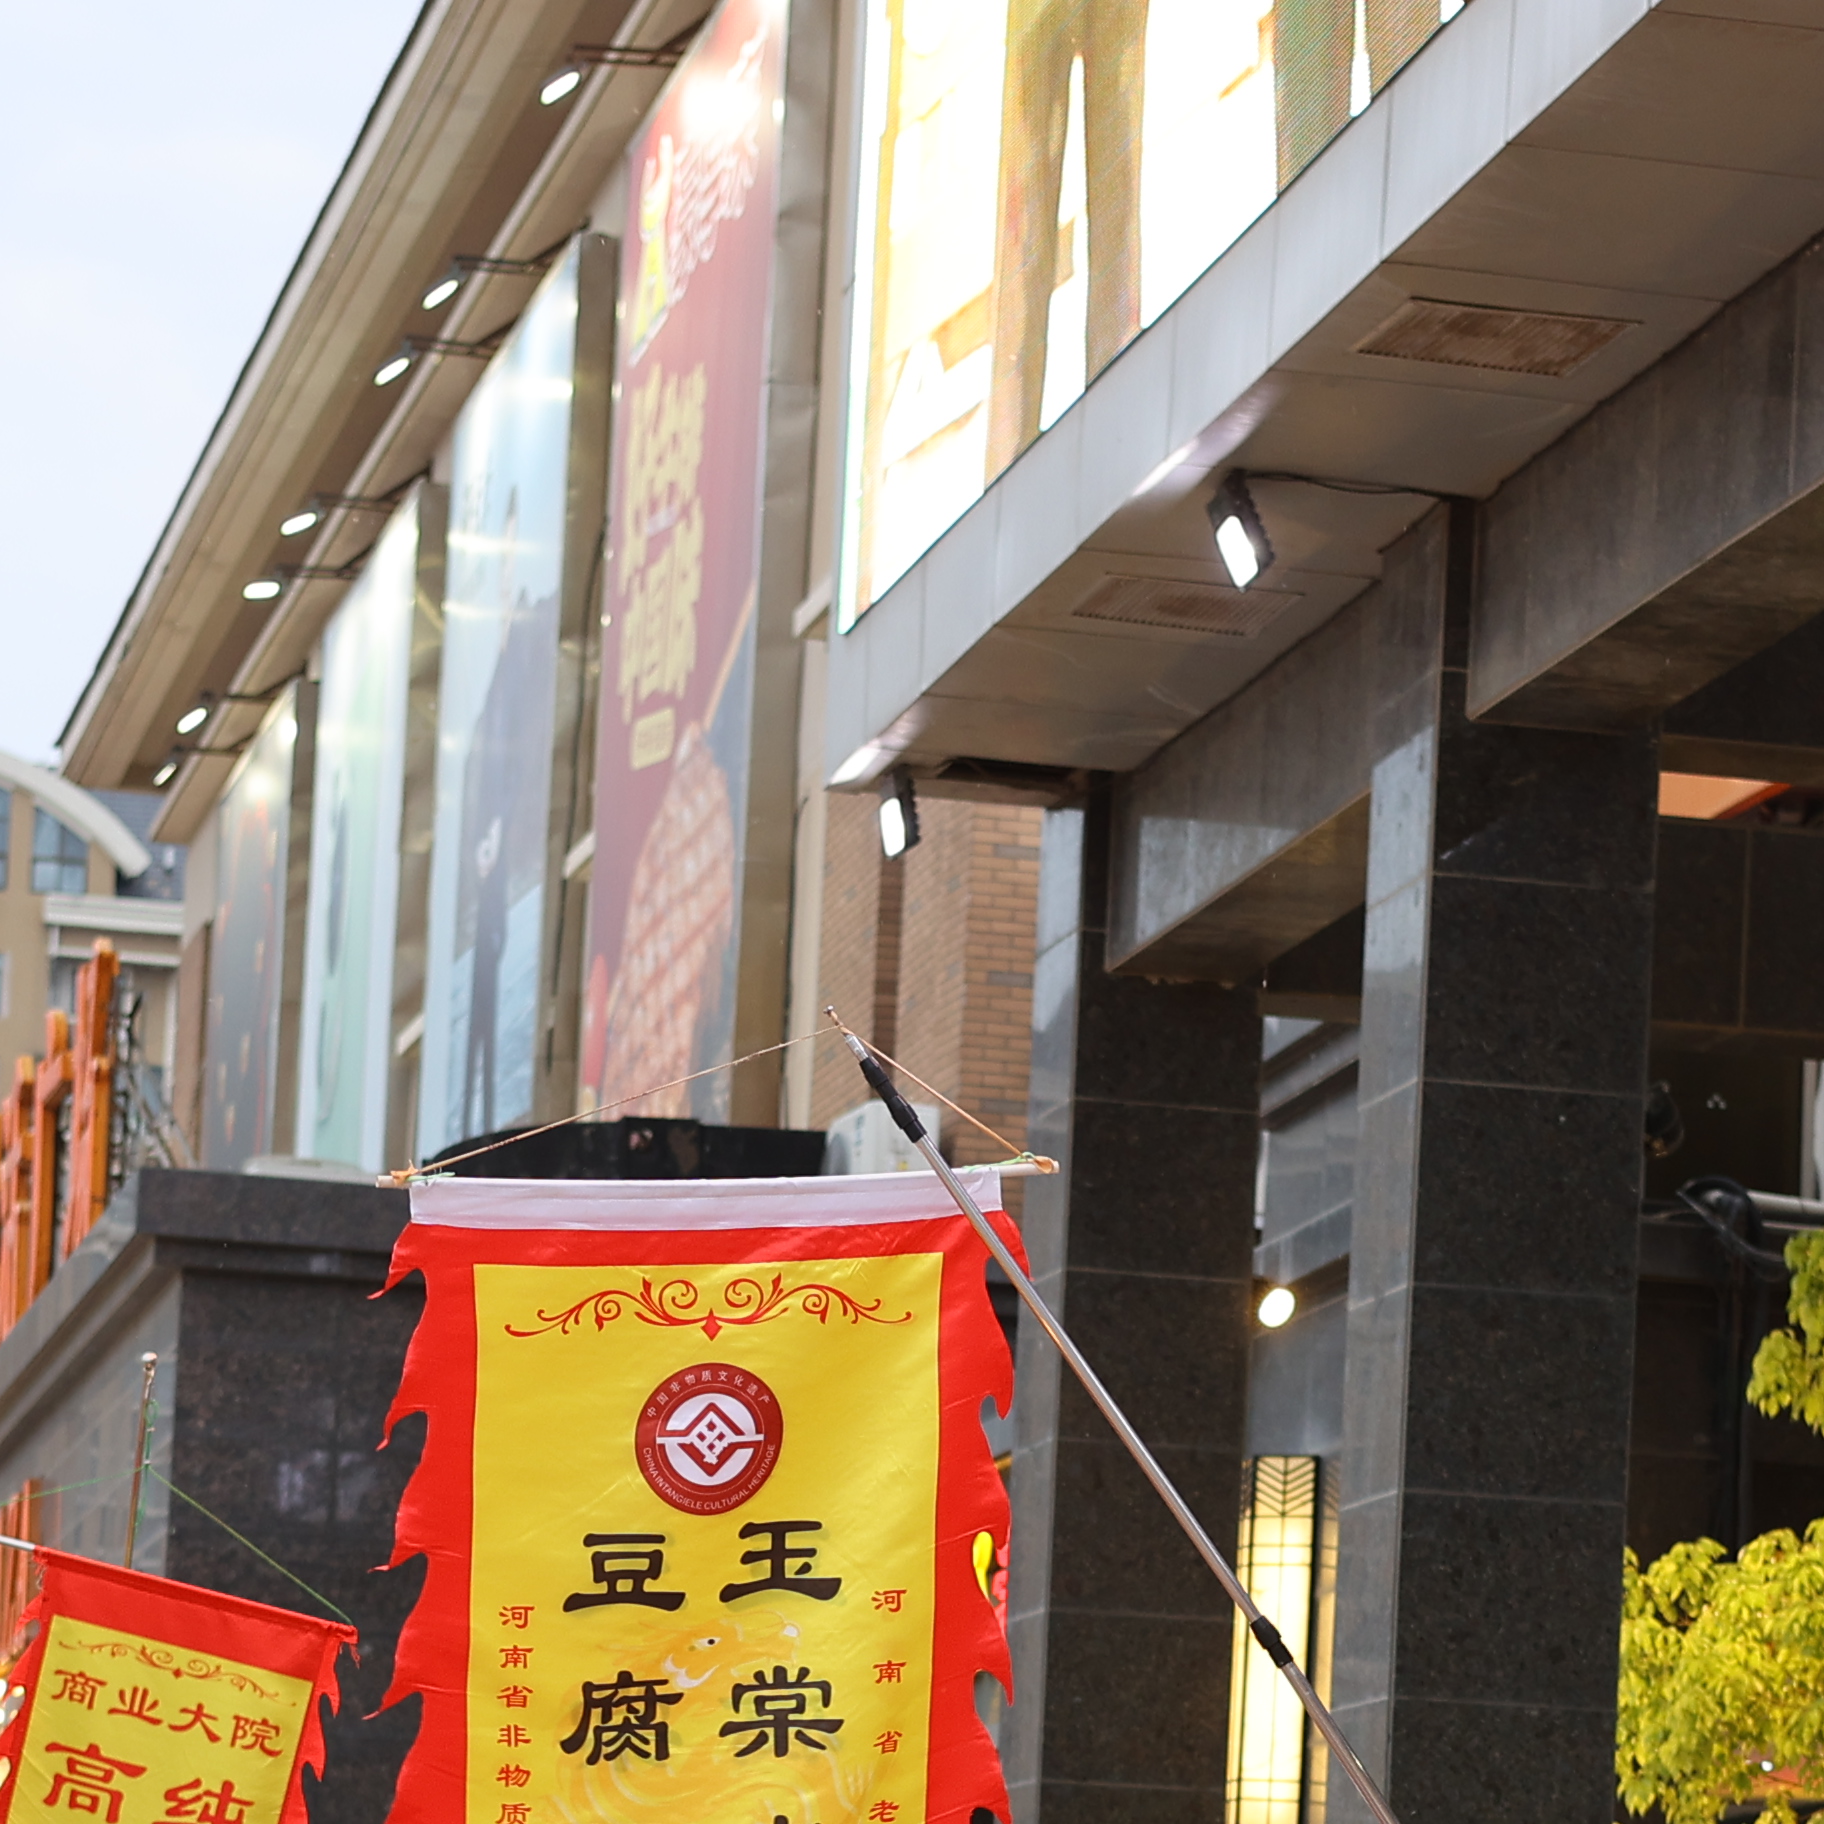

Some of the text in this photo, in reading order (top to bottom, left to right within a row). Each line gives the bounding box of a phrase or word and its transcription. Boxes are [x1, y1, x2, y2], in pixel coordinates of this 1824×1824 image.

[646, 1369, 771, 1418] 中国非物质文化遗产
[51, 1668, 284, 1759] 商业大院
